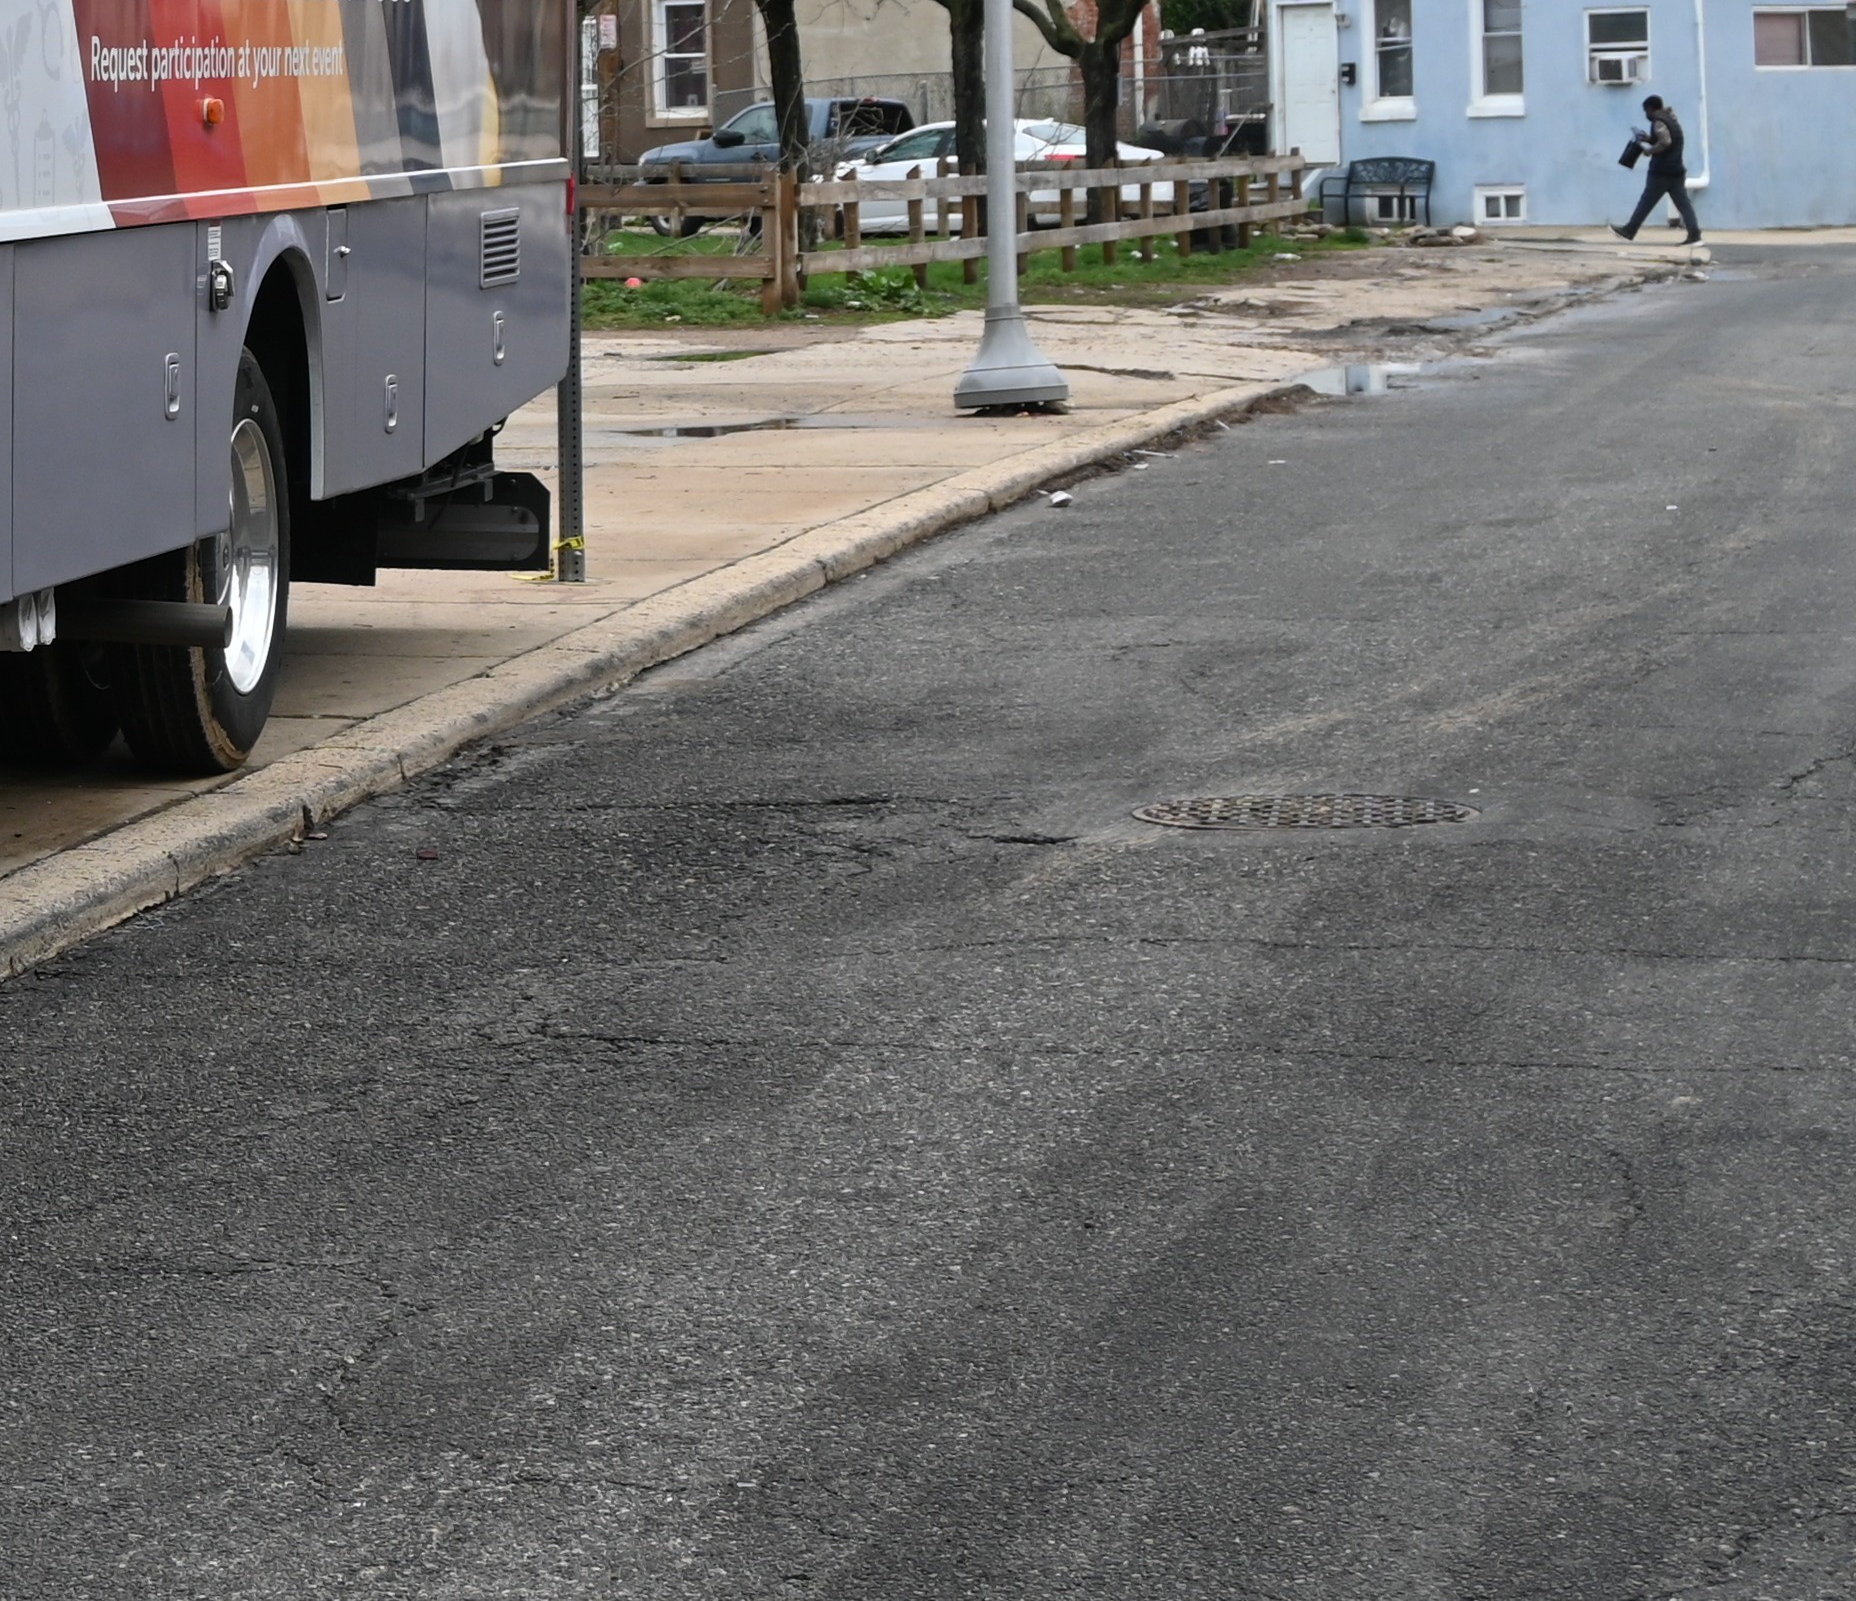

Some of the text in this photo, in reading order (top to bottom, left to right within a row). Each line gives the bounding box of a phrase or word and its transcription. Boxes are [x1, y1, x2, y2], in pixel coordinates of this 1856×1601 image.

[91, 35, 344, 93] Request participation at your next event
